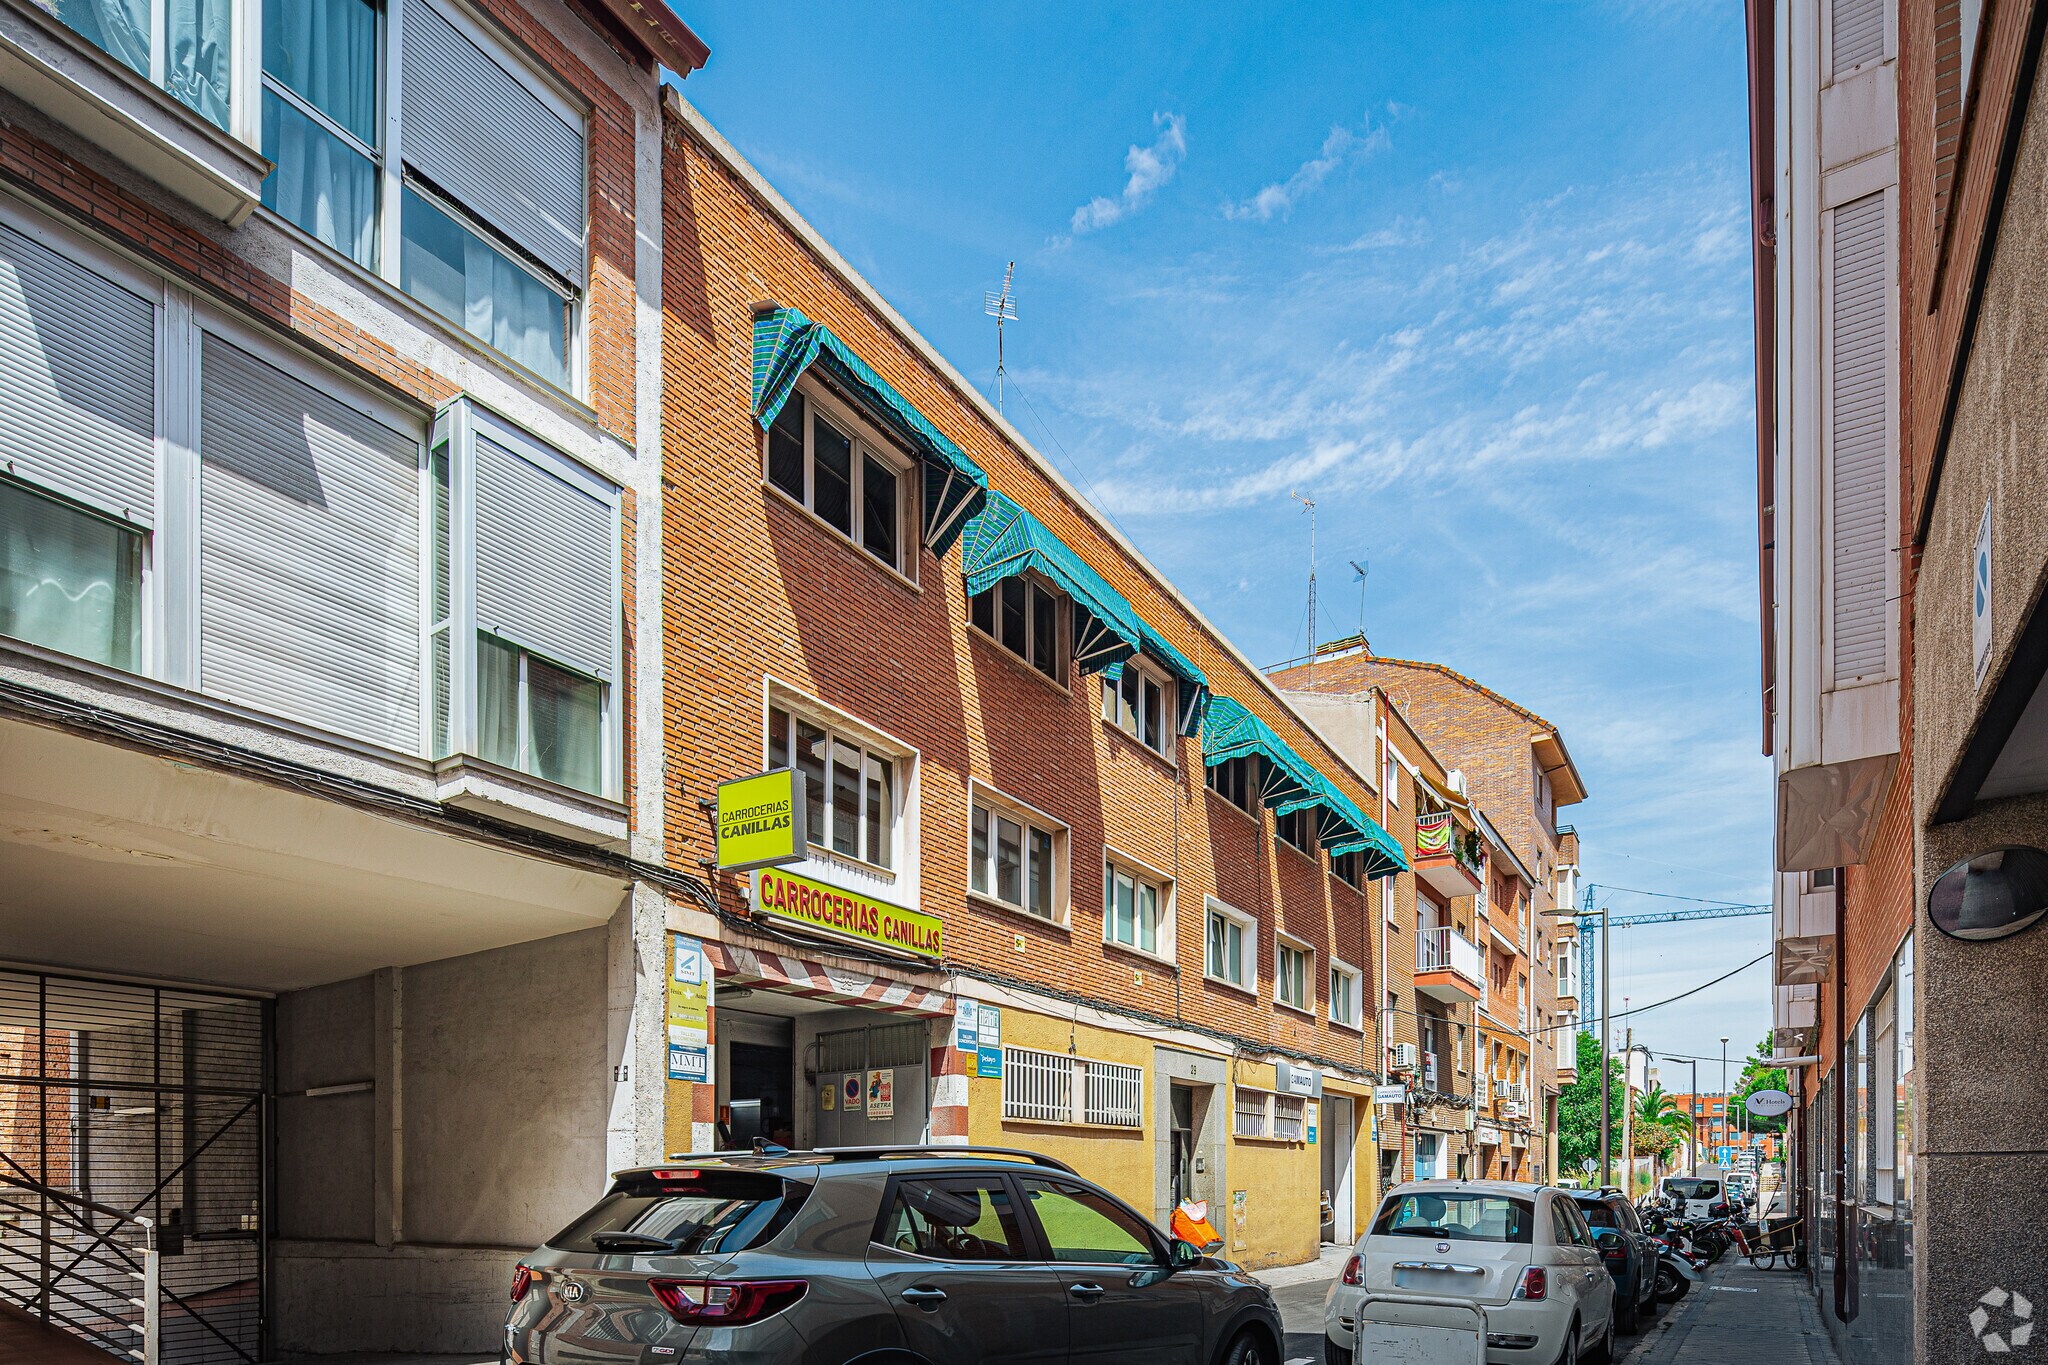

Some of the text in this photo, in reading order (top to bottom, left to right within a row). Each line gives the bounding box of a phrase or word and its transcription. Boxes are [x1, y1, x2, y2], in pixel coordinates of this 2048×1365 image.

[721, 799, 789, 823] CARROCERIAS
[721, 814, 790, 839] CANILLAS
[760, 873, 940, 953] CARROCERIAS CANILLAS
[671, 1053, 705, 1068] MMT
[1291, 1074, 1312, 1088] GAMAUTO
[565, 1286, 579, 1298] KIA
